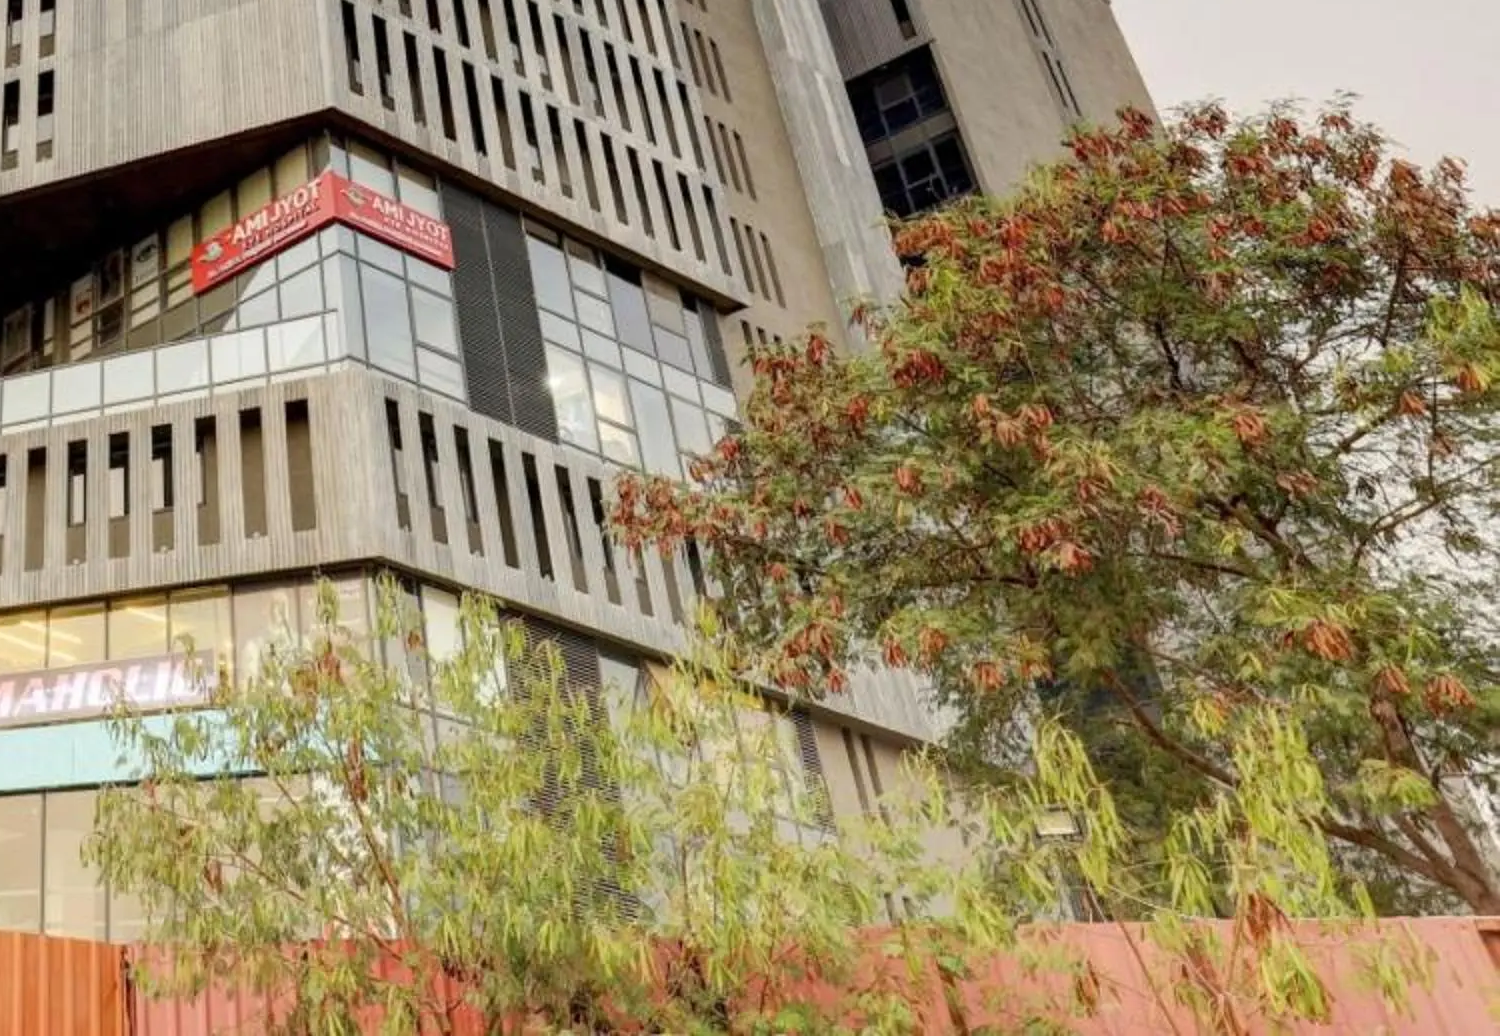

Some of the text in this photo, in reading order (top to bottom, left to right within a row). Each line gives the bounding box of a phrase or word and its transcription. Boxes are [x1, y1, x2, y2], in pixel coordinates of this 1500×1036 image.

[231, 177, 322, 245] AMI JYOT
[372, 196, 405, 222] AMI
[407, 210, 450, 243] JYOT
